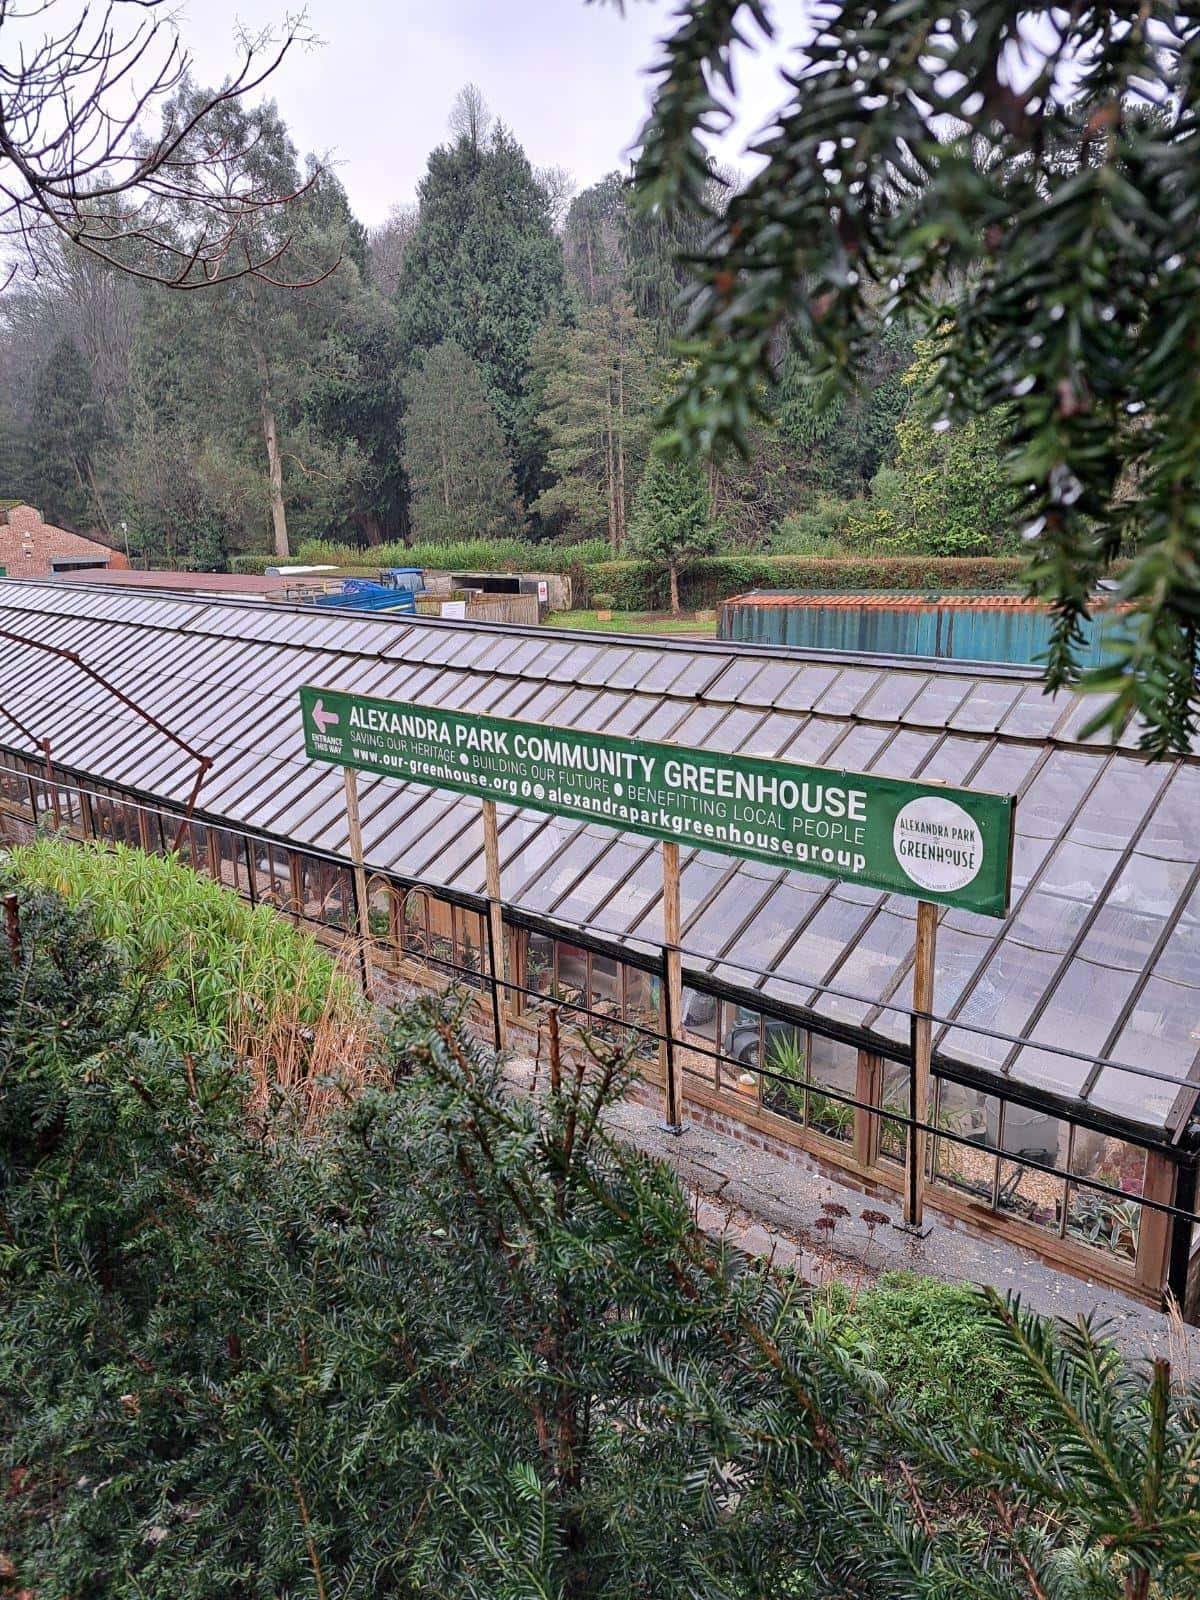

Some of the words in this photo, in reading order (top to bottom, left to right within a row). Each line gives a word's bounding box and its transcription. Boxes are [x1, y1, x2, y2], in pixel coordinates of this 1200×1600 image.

[311, 733, 344, 747] ENTRANCE
[349, 706, 451, 745] ALEXANDRA
[455, 724, 510, 755] PARK
[514, 734, 656, 783] COMMUNITY
[664, 760, 867, 822] GREENHOUSE
[350, 731, 385, 748] SAVING
[387, 737, 408, 753] OUR
[411, 743, 457, 764] HERITAGE
[472, 754, 528, 777] BUILDING
[531, 765, 556, 783] OUR
[559, 771, 610, 795] FUTURE
[628, 785, 727, 818] BENEFITTING
[733, 804, 786, 831] LOCAL
[793, 816, 866, 846] PEOPLE
[352, 748, 518, 796] www.our-greenhouse.org
[548, 787, 866, 873] alexandraparkgreenhousegroup
[899, 839, 975, 870] GREENHOUSE
[900, 817, 949, 839] ALEXANDRA
[952, 827, 976, 843] PARK
